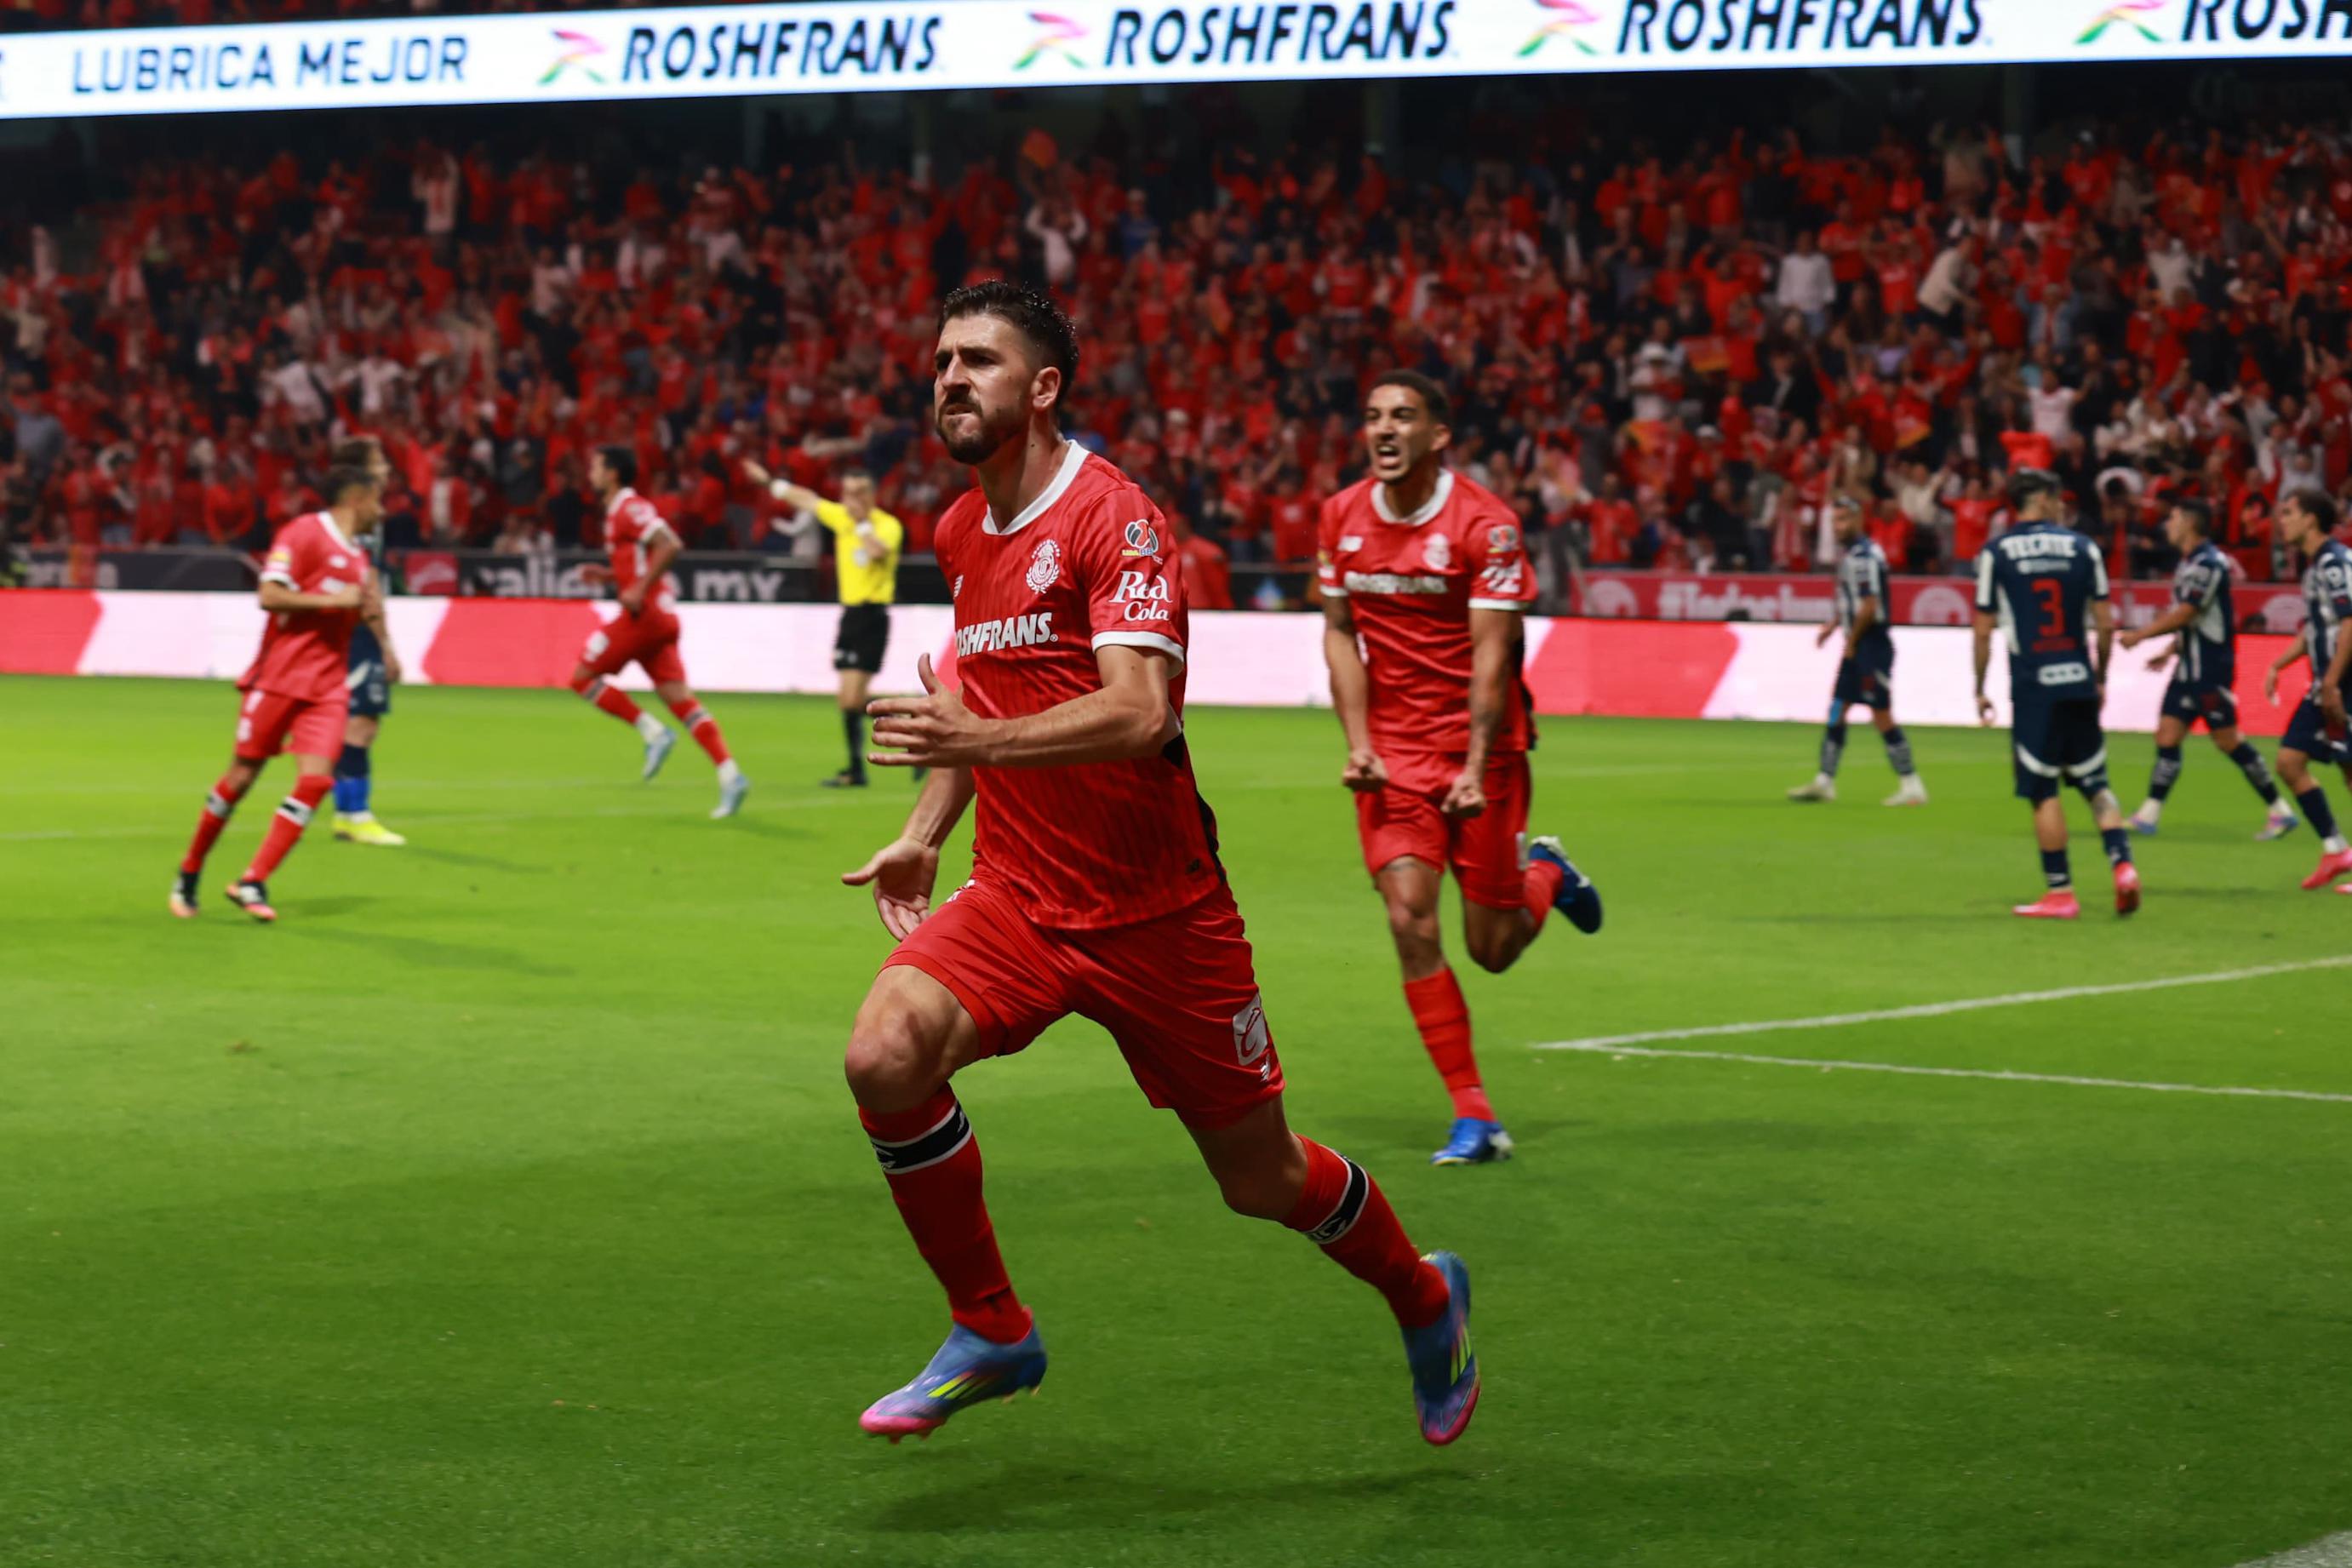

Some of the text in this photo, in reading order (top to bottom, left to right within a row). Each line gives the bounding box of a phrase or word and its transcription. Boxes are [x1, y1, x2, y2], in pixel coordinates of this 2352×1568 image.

[621, 16, 941, 82] ROSHFRANS
[1103, 1, 1456, 66] ROSHFRANS
[1615, 0, 1983, 54] ROSHFRANS
[73, 36, 467, 94] LUBRICA MEJOR
[1108, 570, 1173, 604] Red
[1124, 600, 1170, 621] Cola
[2031, 578, 2065, 638] 3
